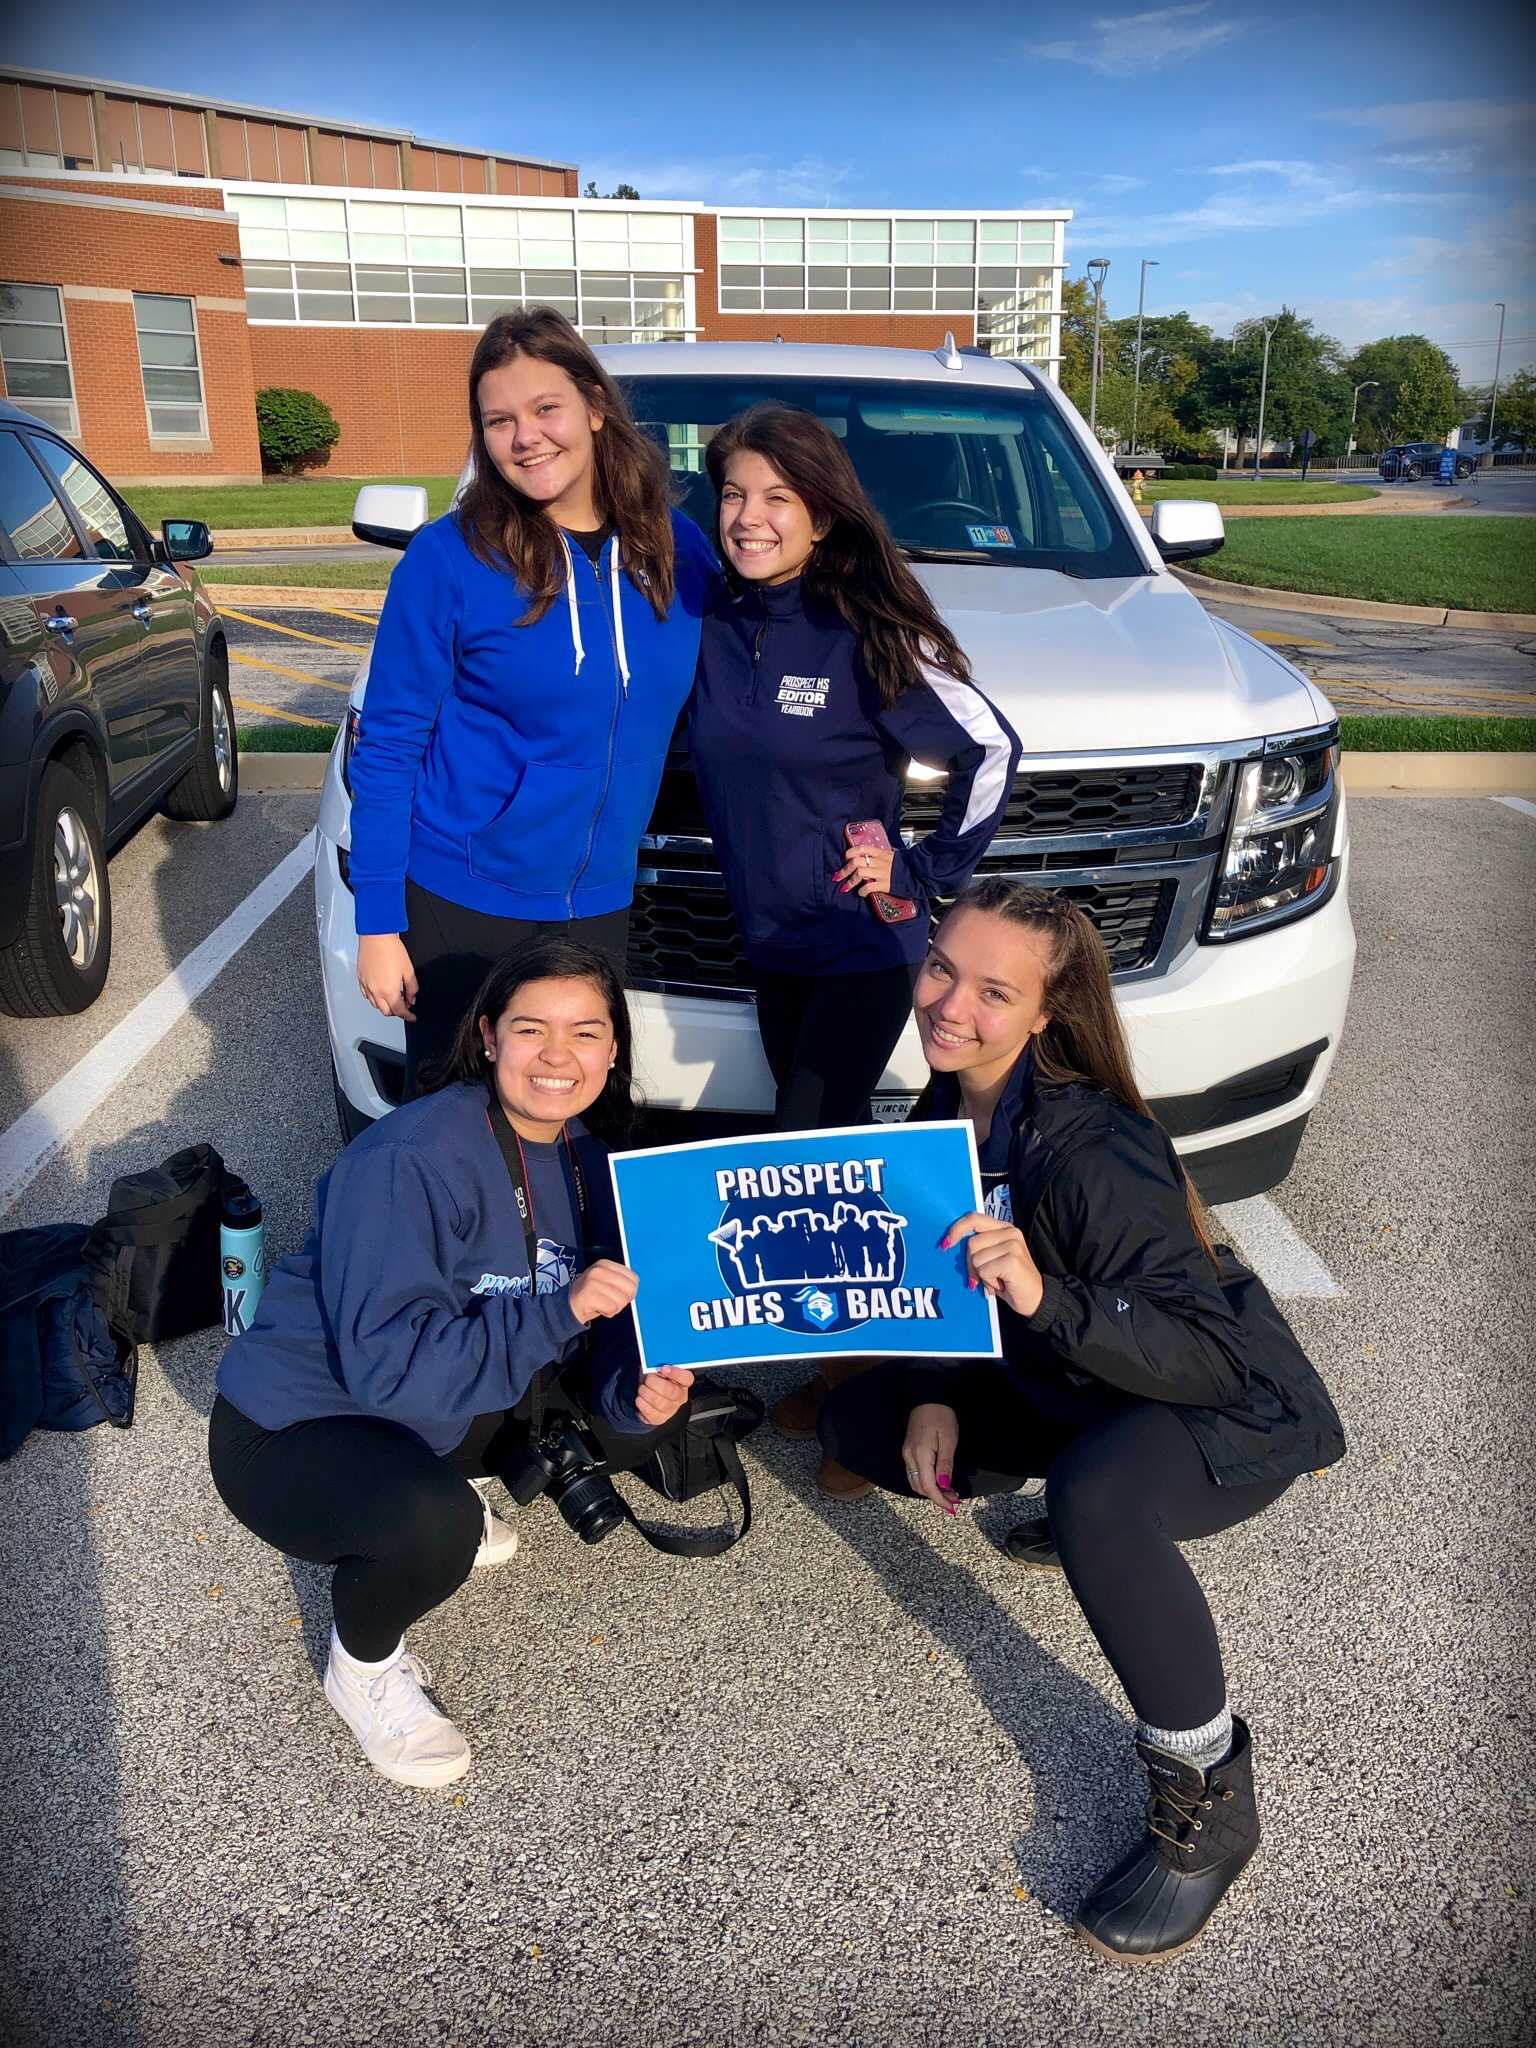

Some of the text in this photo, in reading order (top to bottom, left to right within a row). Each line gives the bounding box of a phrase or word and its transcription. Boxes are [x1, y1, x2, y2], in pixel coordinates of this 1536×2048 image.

[971, 528, 1009, 543] 11 19
[781, 675, 830, 690] PROSPECT HS
[777, 688, 826, 705] EDITOR
[781, 704, 815, 718] YEARBOOK
[875, 1103, 910, 1113] LINCOL
[715, 1157, 886, 1202] PROSPECT
[514, 1187, 528, 1219] EOS
[227, 1288, 246, 1335] K
[689, 1286, 940, 1332] GIVES BACK
